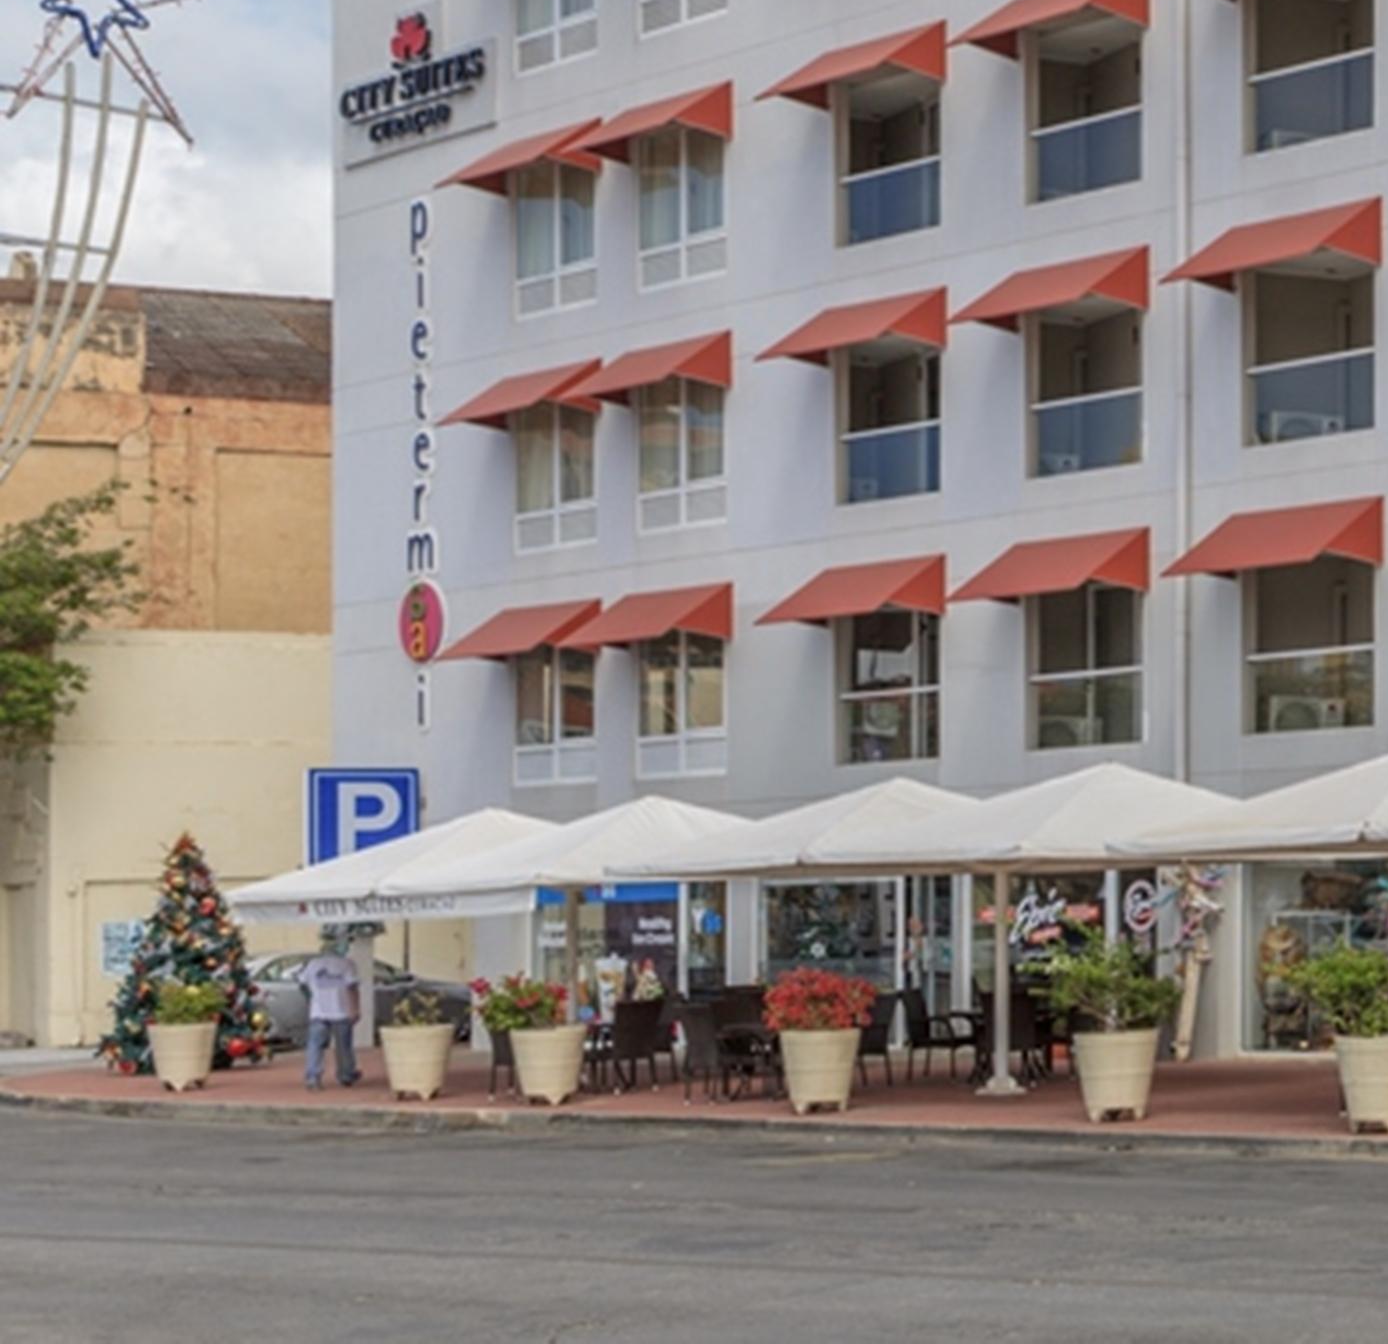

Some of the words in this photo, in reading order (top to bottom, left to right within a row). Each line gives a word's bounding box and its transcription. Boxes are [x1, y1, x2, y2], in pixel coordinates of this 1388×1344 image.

[340, 76, 396, 119] CITY
[400, 48, 485, 100] SUITES
[338, 781, 402, 857] P
